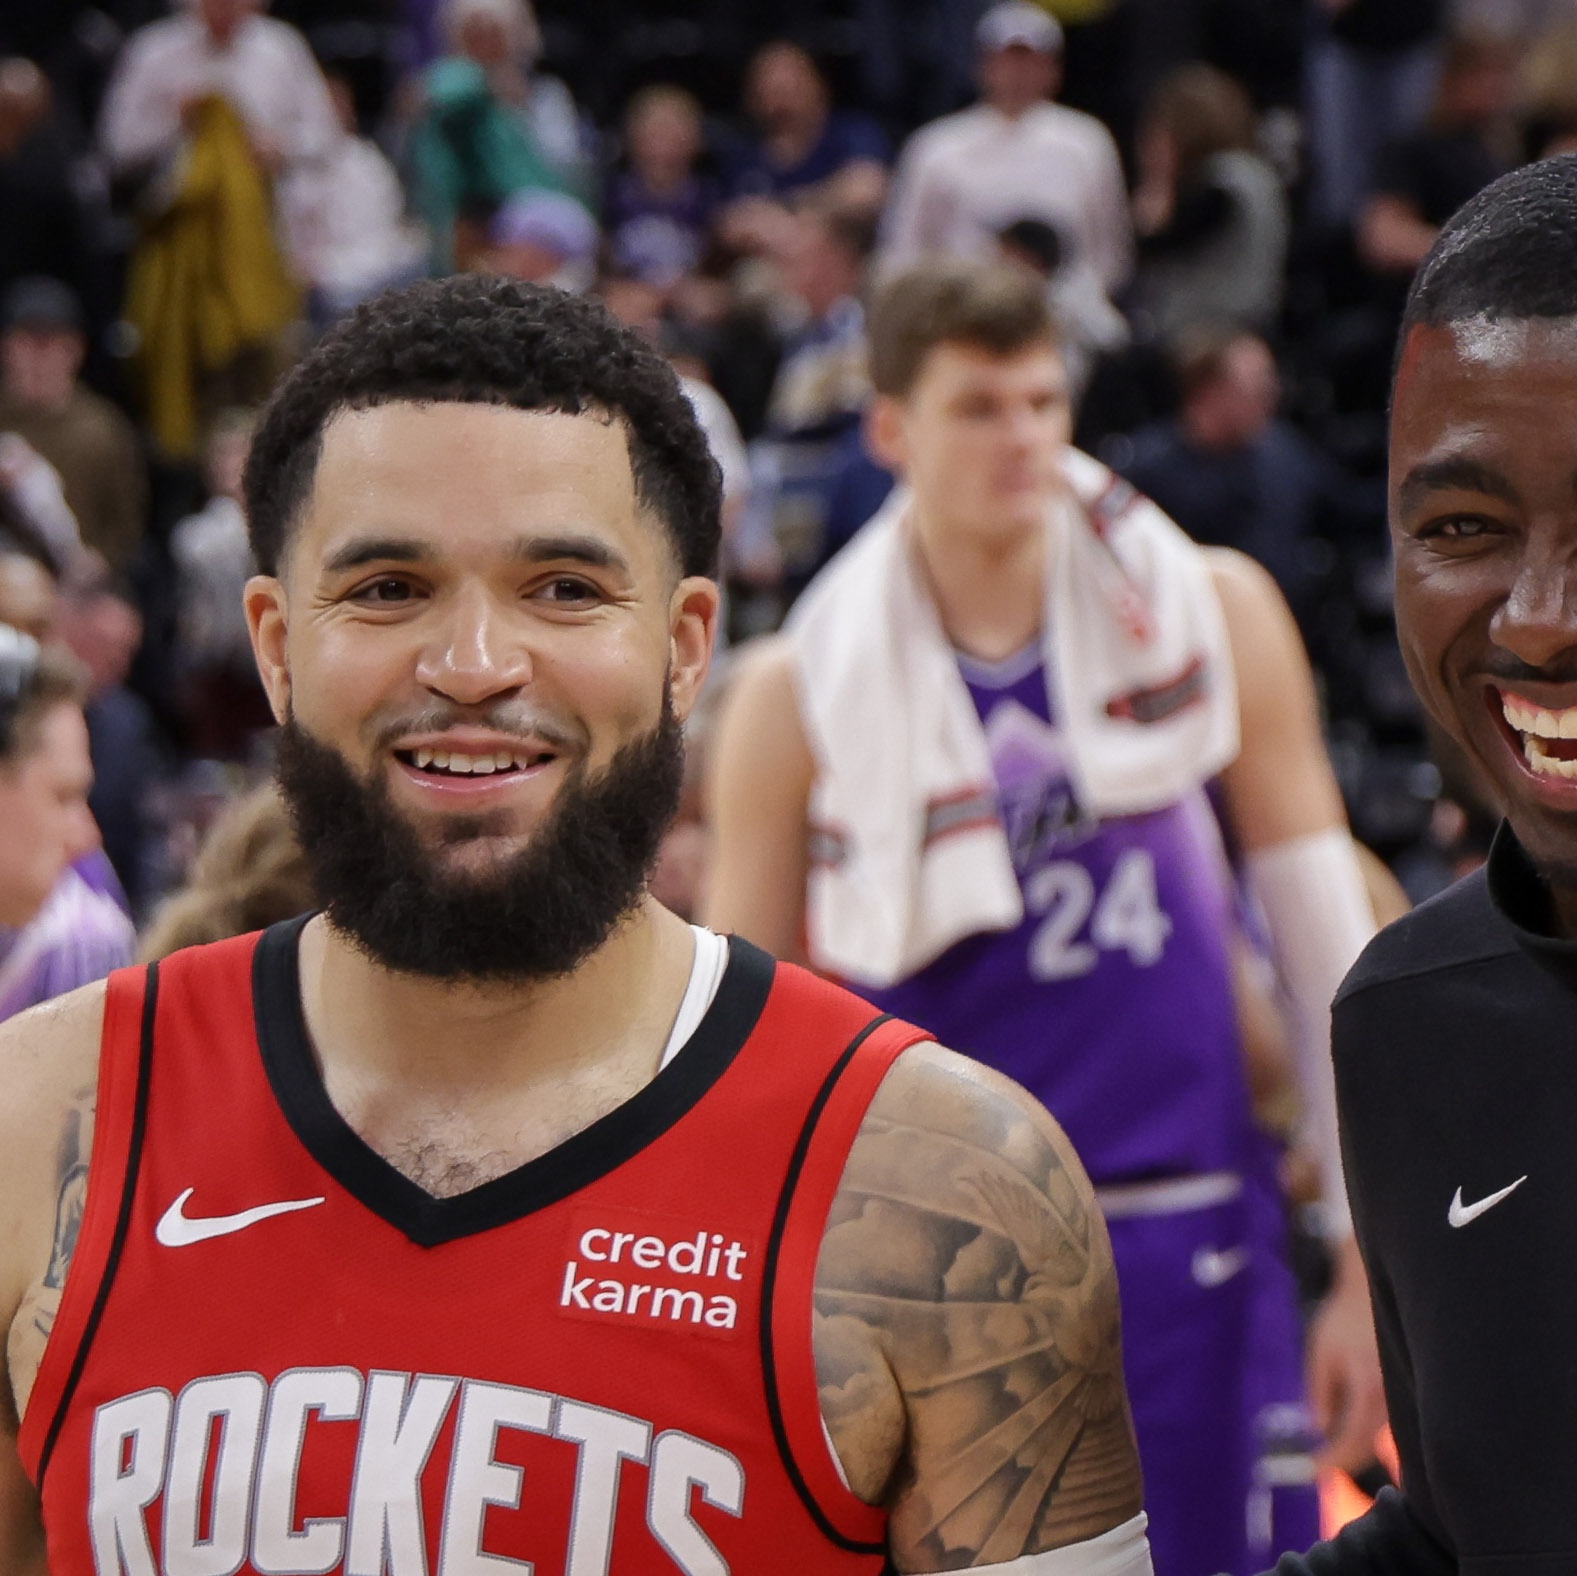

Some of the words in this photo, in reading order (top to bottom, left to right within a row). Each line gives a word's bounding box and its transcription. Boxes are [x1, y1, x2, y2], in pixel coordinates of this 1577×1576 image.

[1024, 858, 1173, 985] 24
[579, 1227, 748, 1281] credit
[559, 1260, 738, 1329] karma
